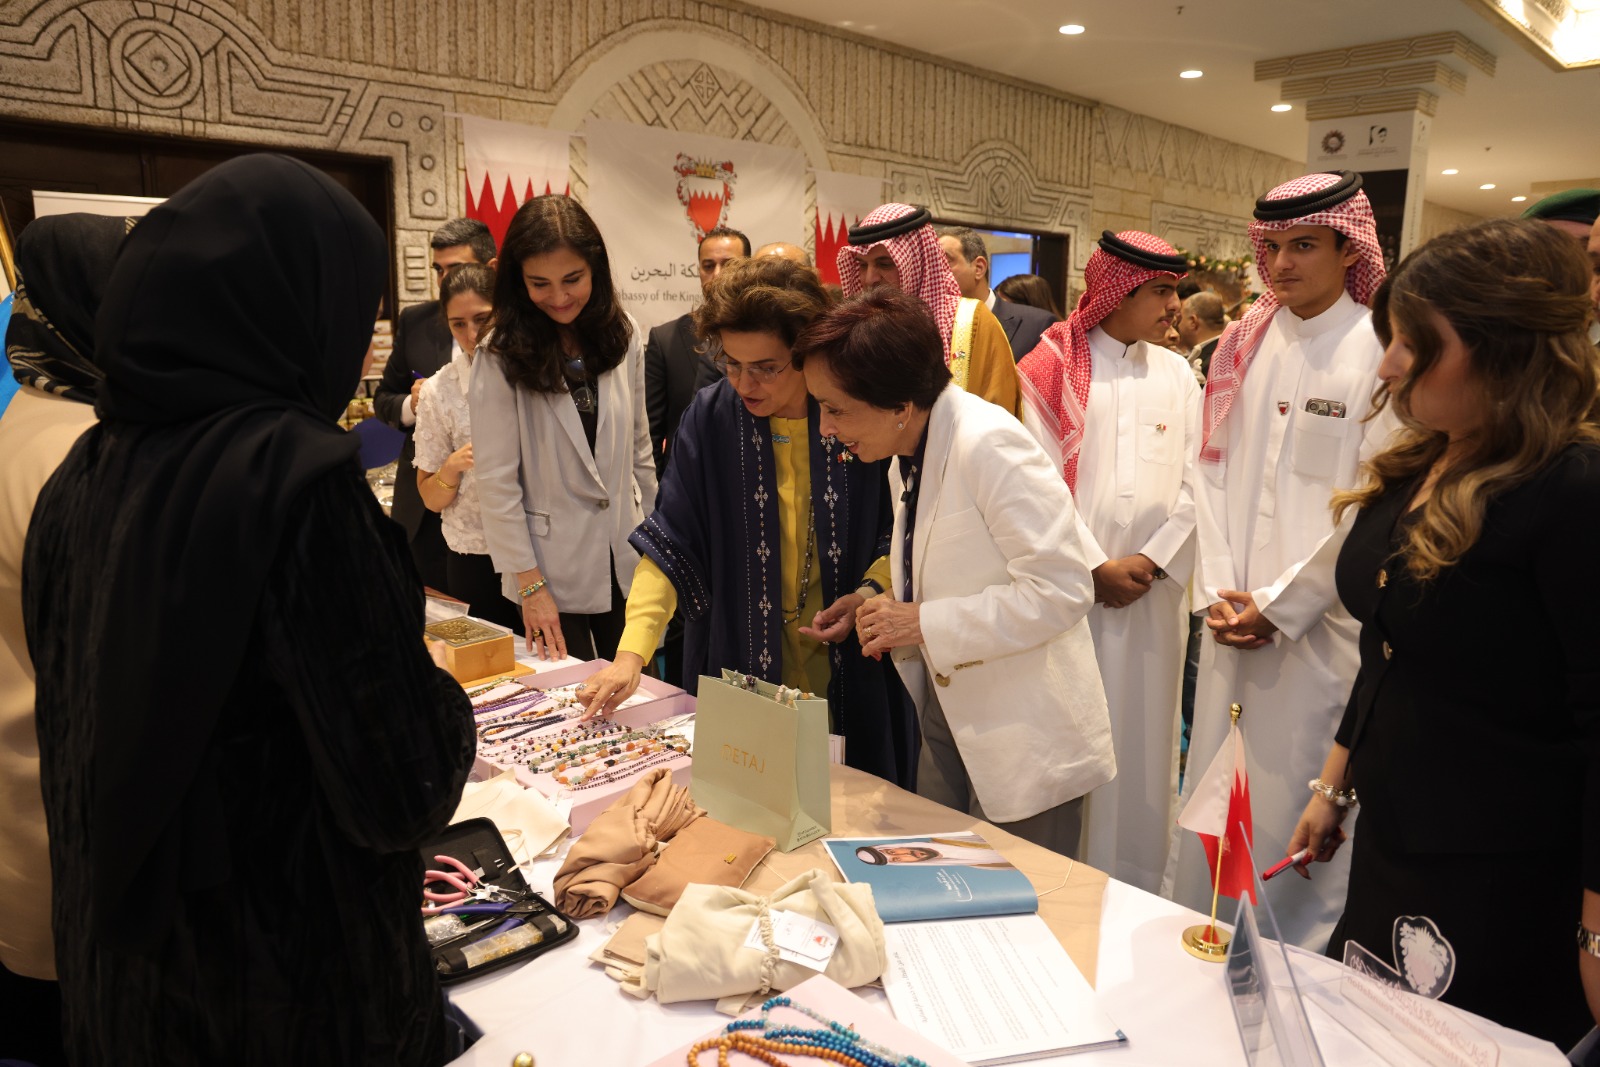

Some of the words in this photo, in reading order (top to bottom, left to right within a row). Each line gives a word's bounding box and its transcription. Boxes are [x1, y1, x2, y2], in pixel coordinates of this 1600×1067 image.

[631, 262, 677, 282] البحرين
[619, 288, 648, 306] bassy
[650, 288, 661, 301] of
[663, 288, 678, 301] the
